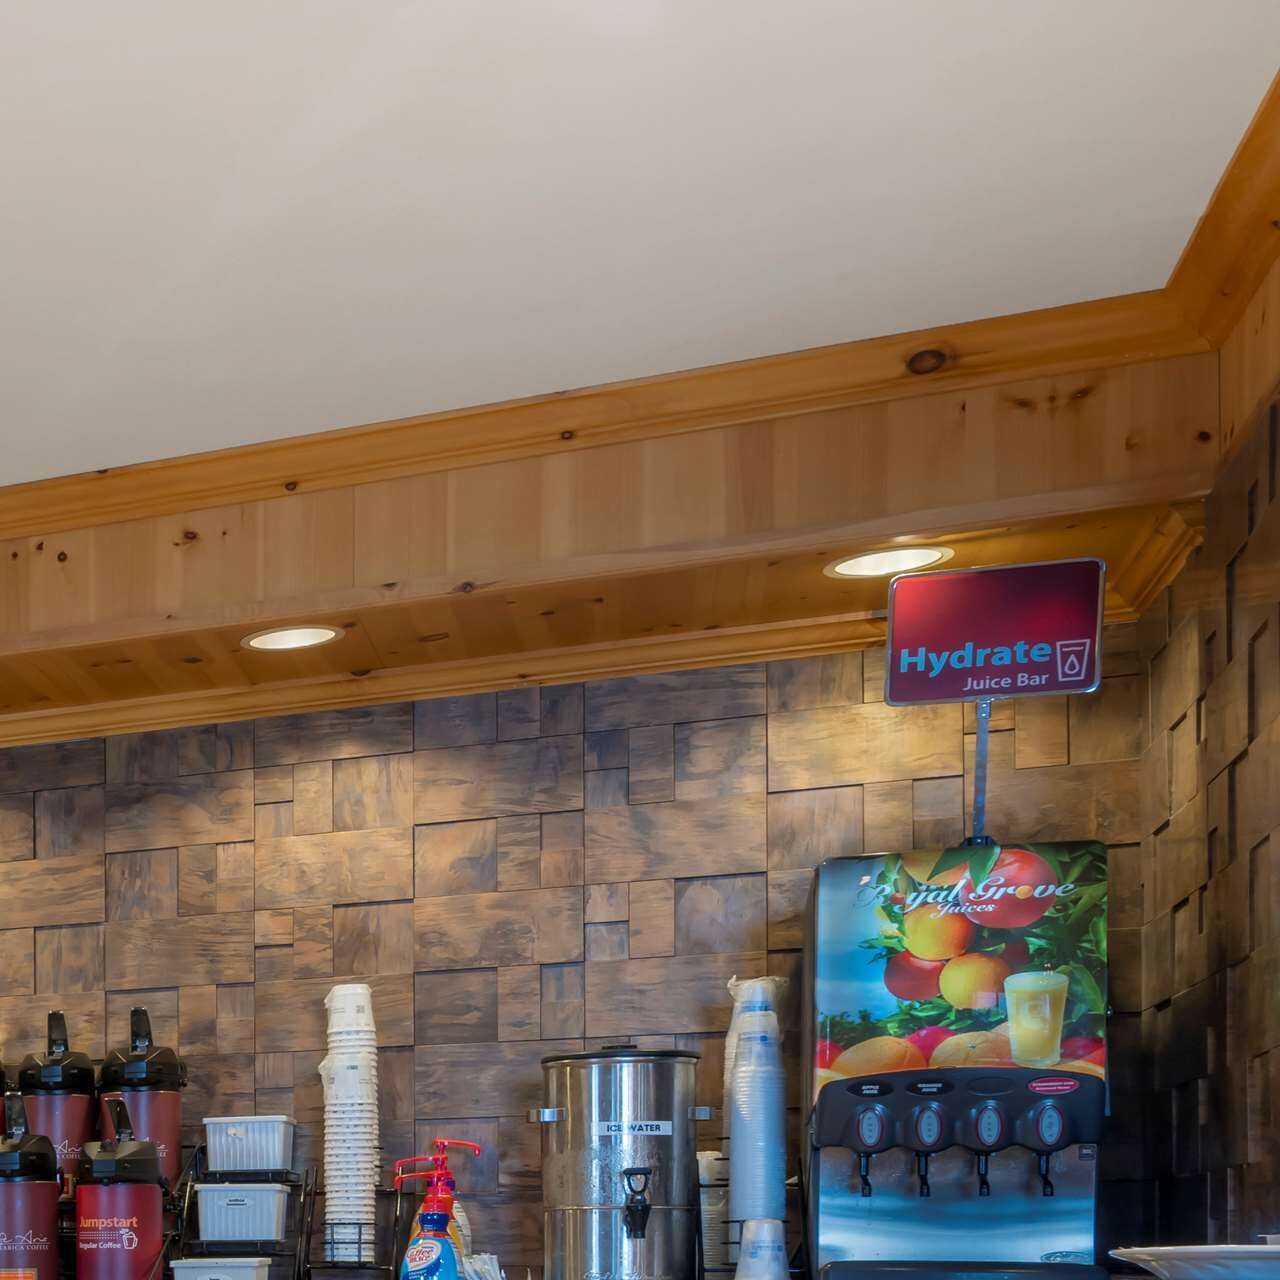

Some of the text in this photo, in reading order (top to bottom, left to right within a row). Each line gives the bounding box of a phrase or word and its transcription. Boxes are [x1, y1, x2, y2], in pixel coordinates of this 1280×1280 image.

[900, 641, 1052, 678] Hydrate
[963, 673, 1050, 691] Juice Bar
[968, 876, 1075, 901] Grove
[930, 901, 997, 919] Juices
[607, 1124, 661, 1132] ICE WATER
[80, 1216, 139, 1230] Jumpstart
[98, 1241, 121, 1249] Coffee
